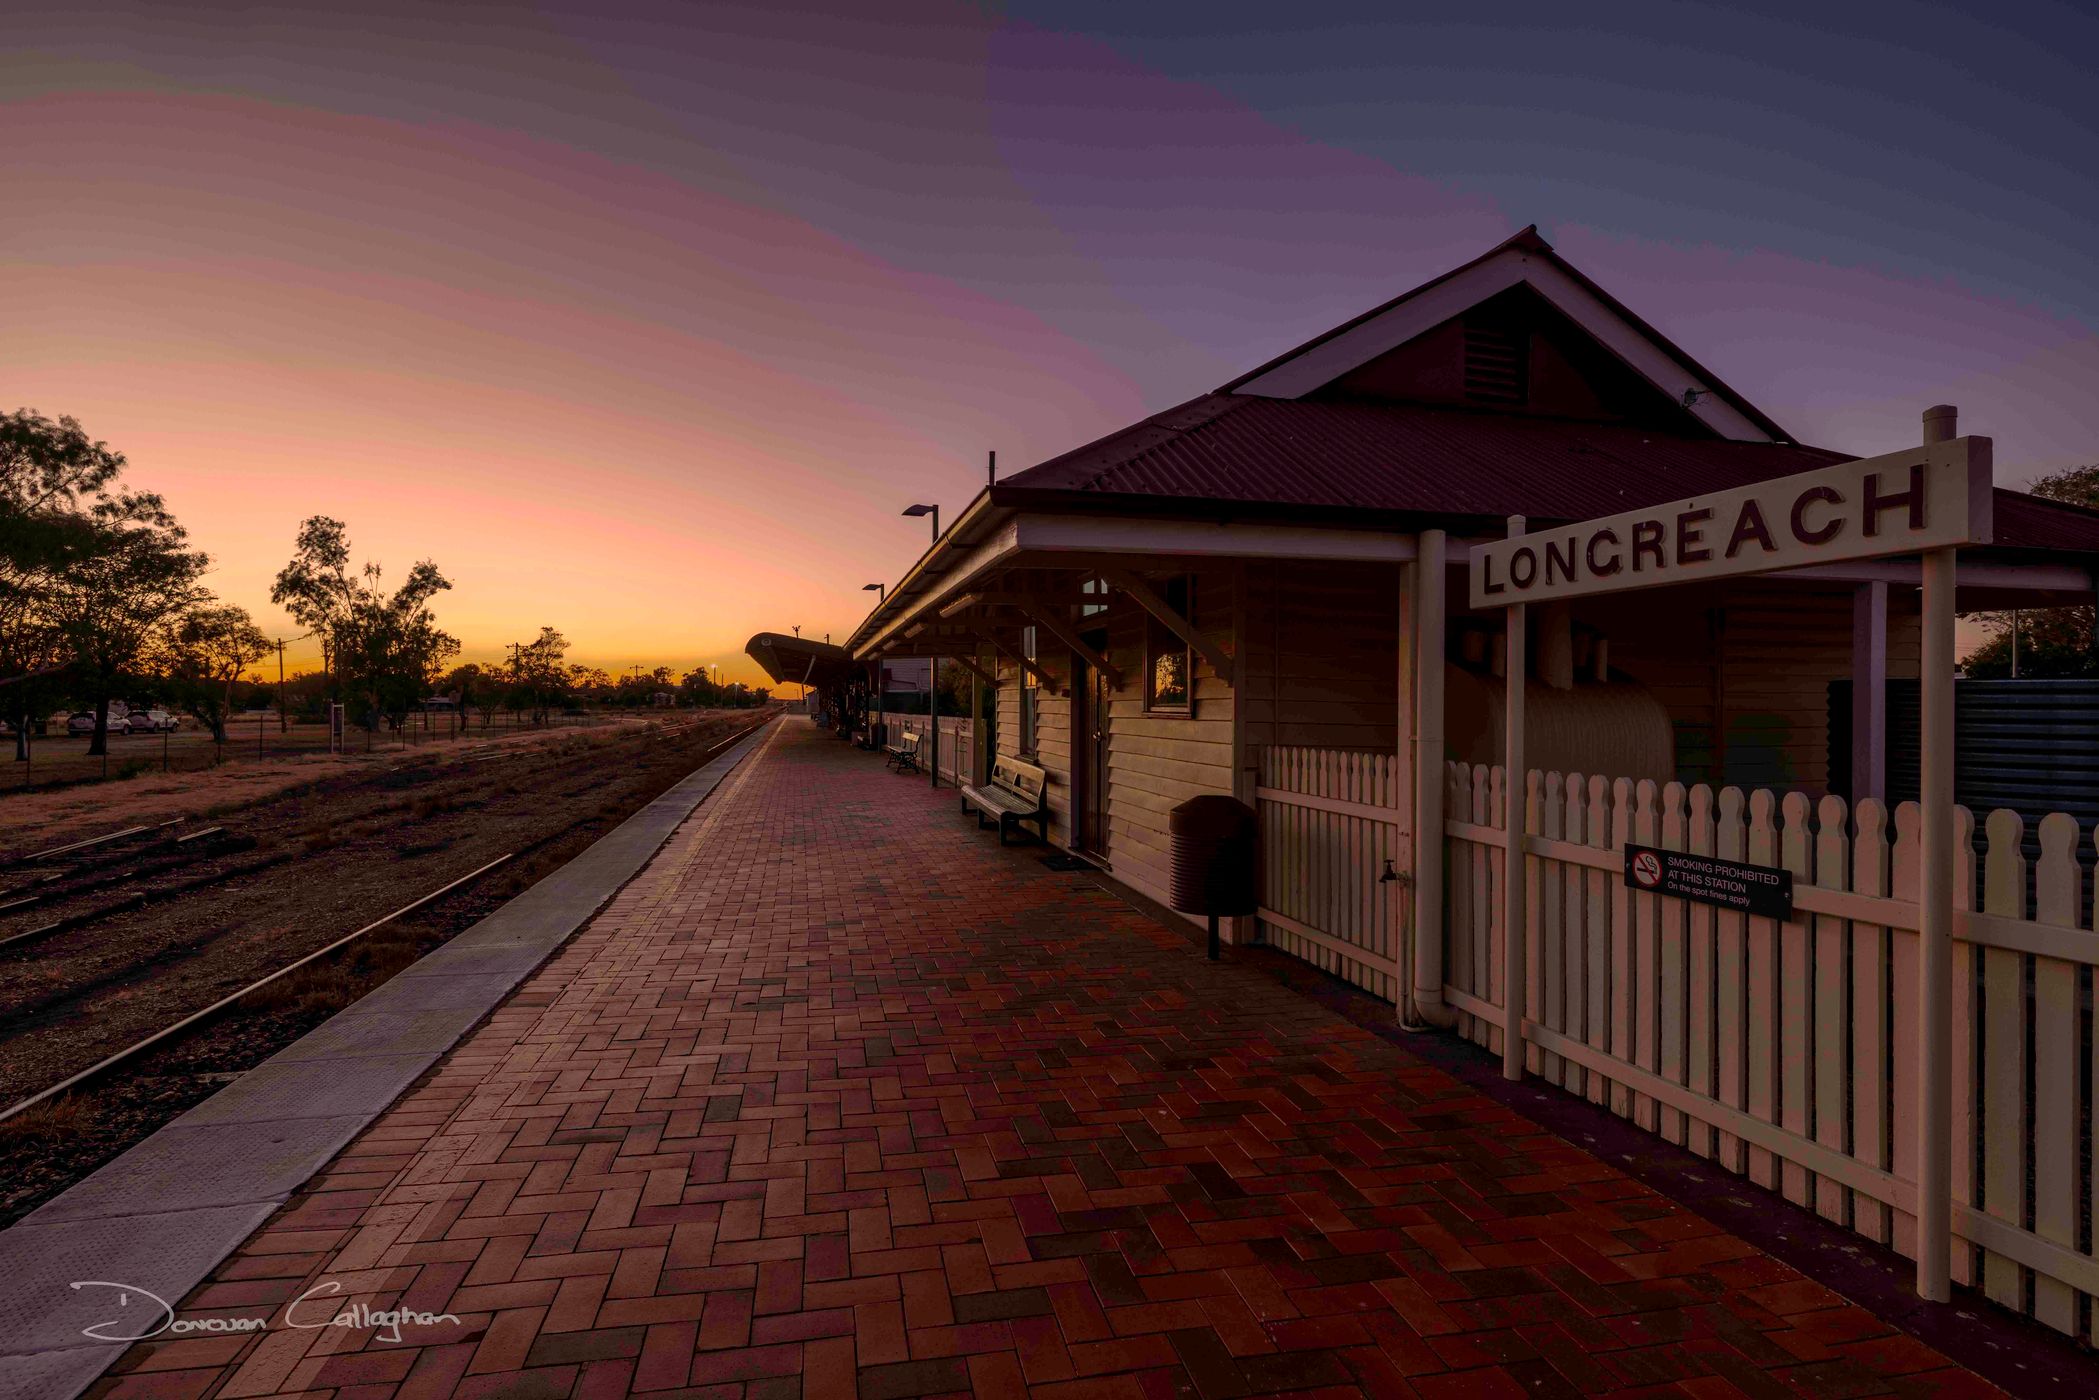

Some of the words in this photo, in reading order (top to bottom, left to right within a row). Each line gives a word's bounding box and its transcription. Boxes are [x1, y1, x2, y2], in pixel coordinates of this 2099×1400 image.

[1483, 463, 1927, 595] LONGREACH
[1667, 857, 1713, 873] SMOKING
[1715, 866, 1779, 885] PROHIBITED
[1668, 870, 1679, 879] AT
[1681, 872, 1702, 884] THIS
[1704, 877, 1746, 893] STATION
[1668, 882, 1678, 890] On
[1679, 883, 1691, 892] the
[1692, 886, 1708, 897] spot
[1709, 890, 1727, 901] fines
[1729, 895, 1750, 907] apply
